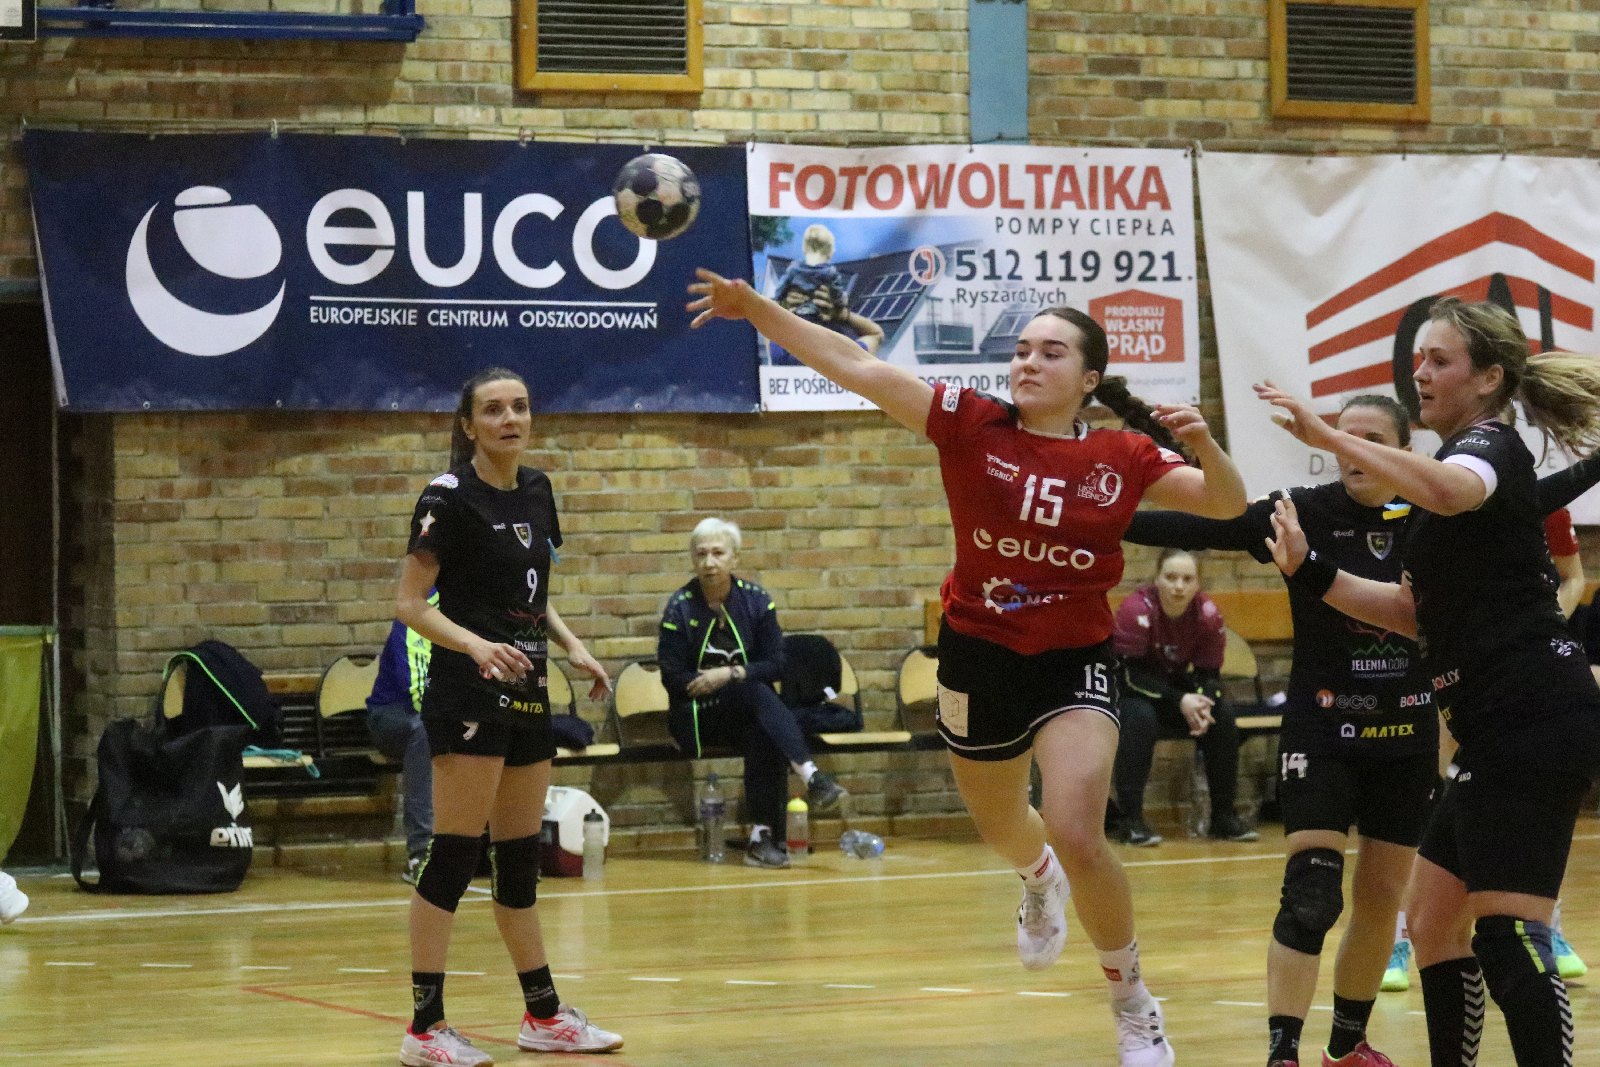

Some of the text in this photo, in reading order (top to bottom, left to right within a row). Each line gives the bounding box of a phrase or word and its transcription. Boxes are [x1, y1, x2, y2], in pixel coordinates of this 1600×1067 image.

[769, 161, 1172, 212] FOTOWOLTAIKA
[306, 187, 658, 290] euco
[995, 216, 1176, 237] POMPY CIEPŁA
[955, 249, 1023, 282] 512
[1035, 250, 1101, 282] 119
[309, 306, 658, 330] EUROPEJSKIE CENTRUM ODSZKODOWAŃ
[1104, 305, 1165, 318] PRODUKUJ
[1104, 317, 1164, 333] WŁASNY
[1106, 333, 1167, 361] PRĄD
[769, 378, 790, 395] BEZ
[969, 375, 990, 392] OD
[1019, 474, 1067, 528] 15
[997, 537, 1095, 570] euco
[526, 567, 538, 603] 9
[1083, 662, 1108, 694] 15
[1351, 660, 1387, 672] JELENIA
[1400, 691, 1432, 709] BOLIX
[1360, 723, 1416, 739] MATEX
[1281, 752, 1309, 782] 14
